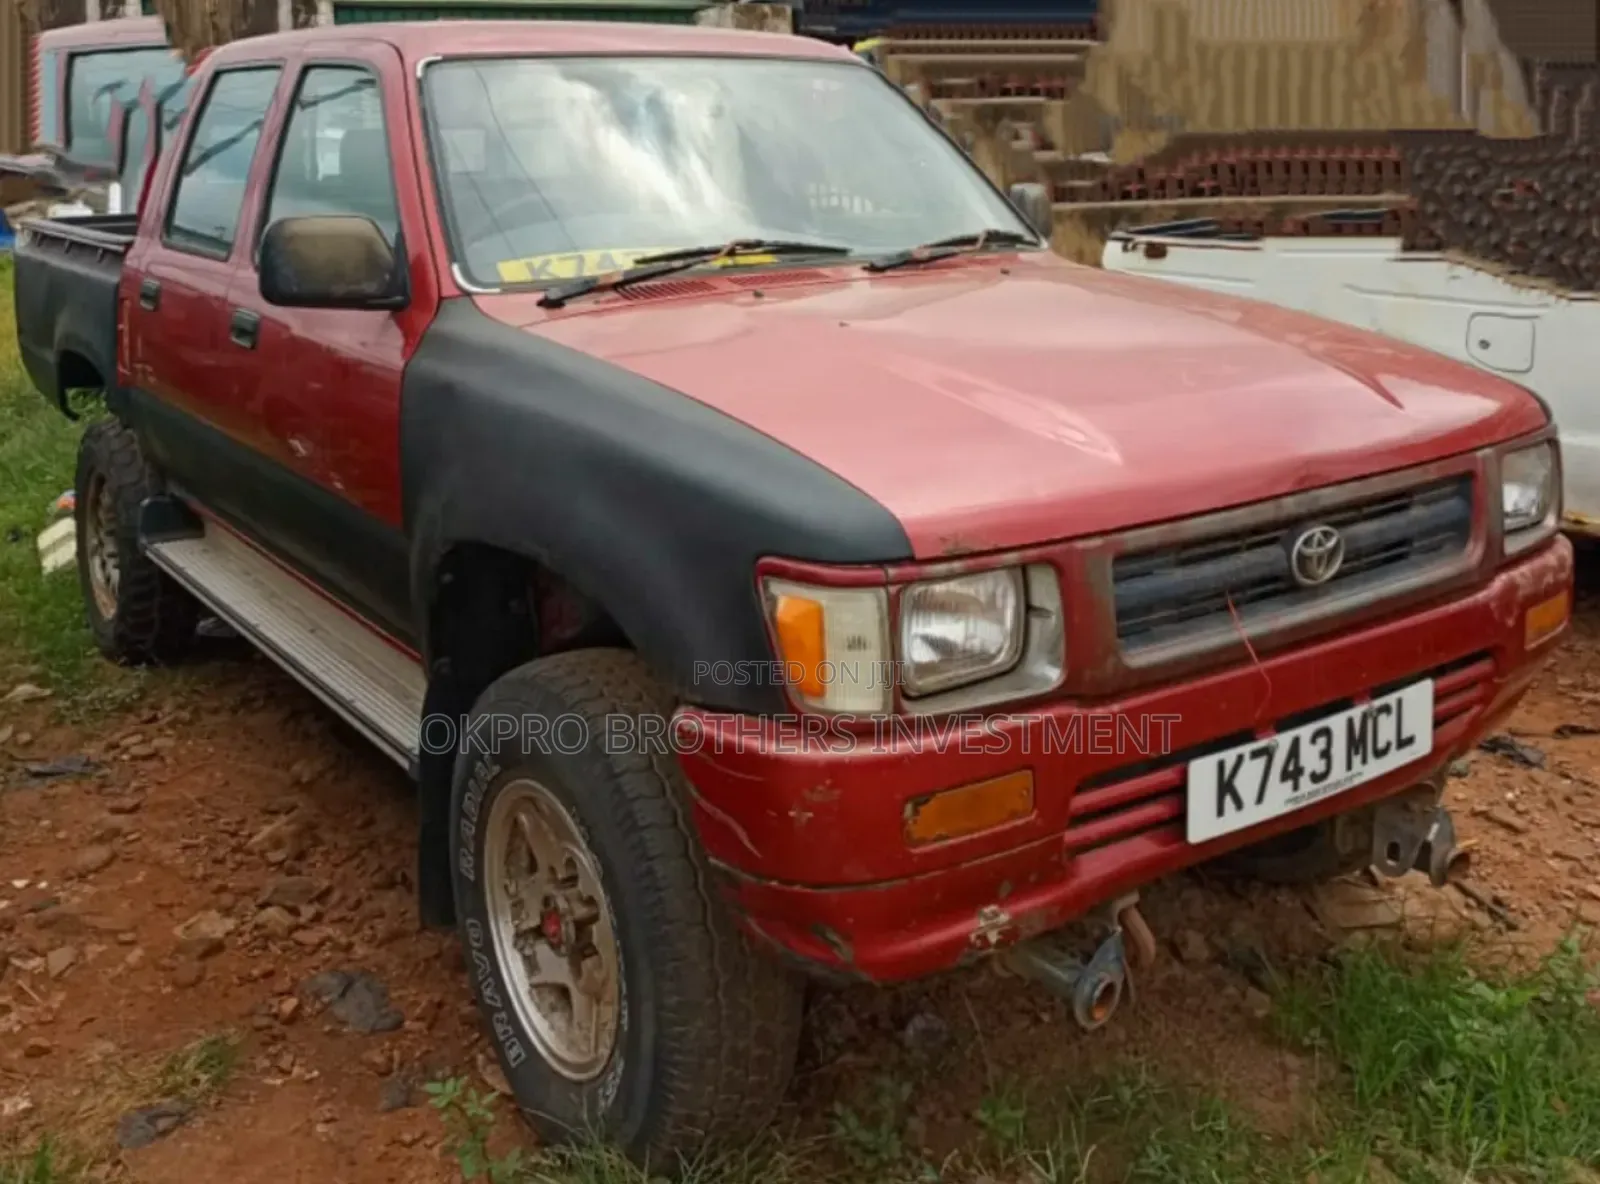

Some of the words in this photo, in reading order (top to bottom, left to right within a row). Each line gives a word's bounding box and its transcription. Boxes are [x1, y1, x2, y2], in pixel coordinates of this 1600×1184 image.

[524, 250, 646, 278] K74
[1216, 726, 1334, 819] K743
[1345, 697, 1416, 772] MCL
[465, 917, 528, 1069] BRAVO
